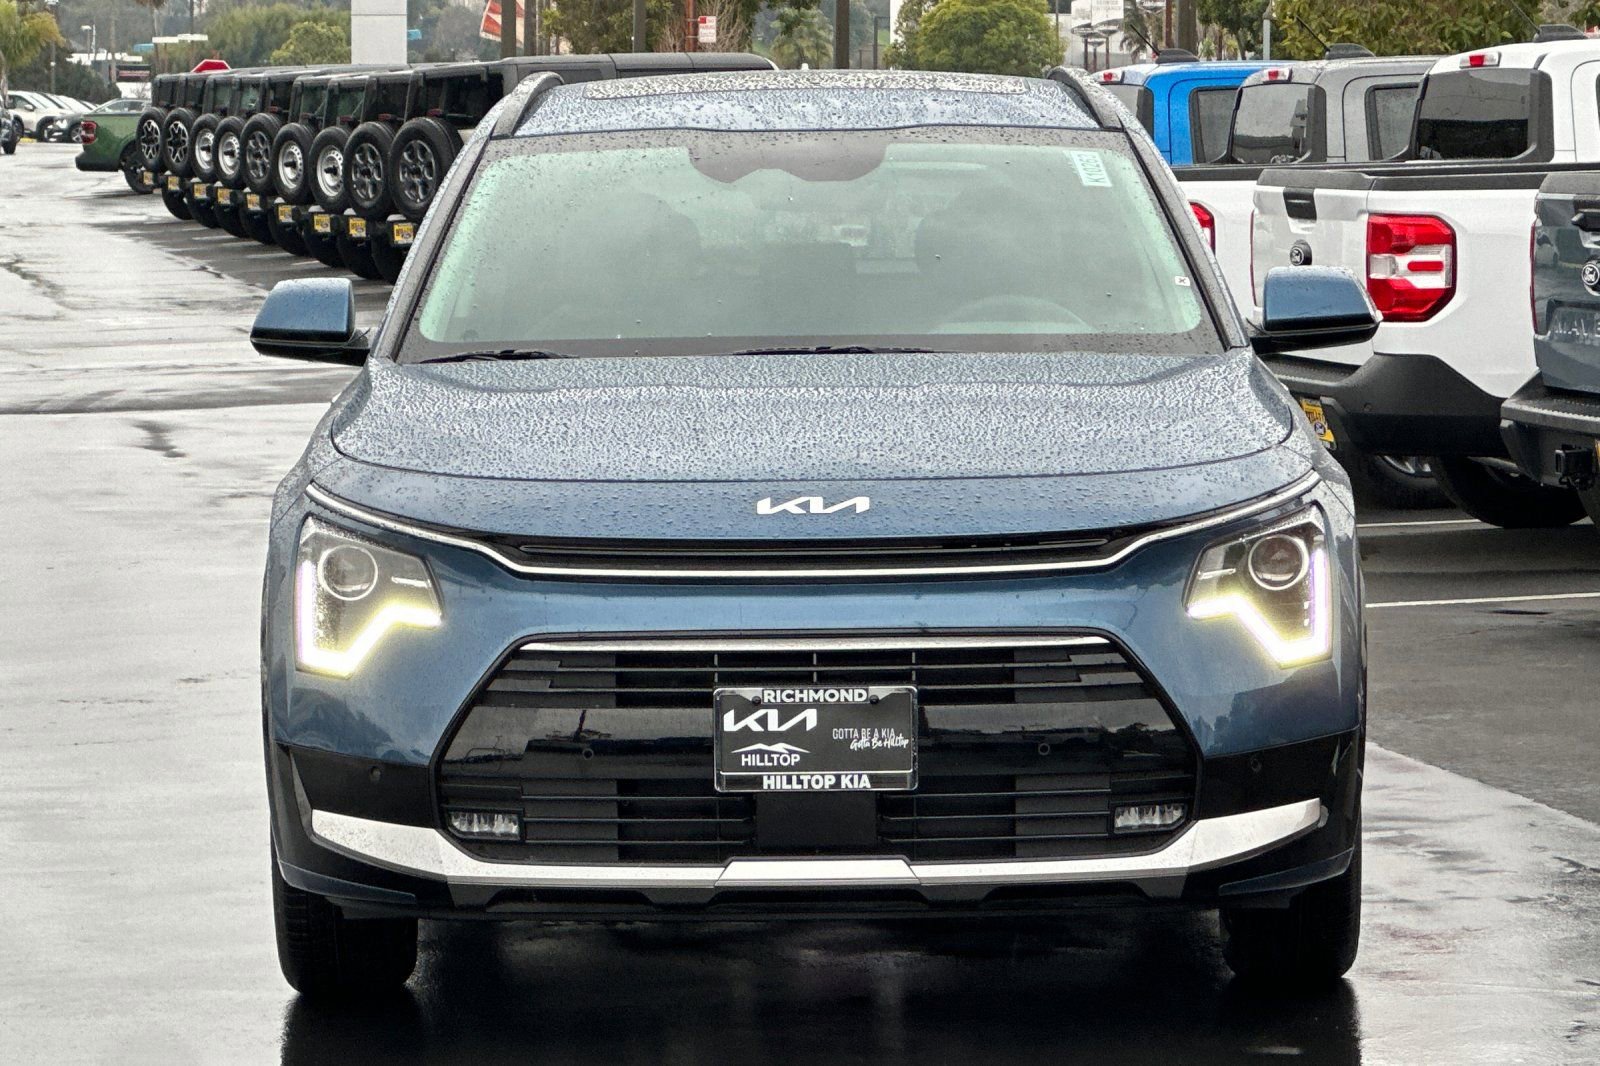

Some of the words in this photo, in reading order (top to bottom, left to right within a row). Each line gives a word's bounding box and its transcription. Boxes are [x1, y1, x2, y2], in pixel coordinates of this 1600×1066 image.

[757, 496, 870, 515] KIA
[763, 689, 868, 703] RICHMOND
[723, 708, 818, 732] KIA
[832, 728, 859, 740] GOTTA
[861, 728, 871, 739] BE
[873, 728, 879, 739] A
[881, 728, 896, 739] KIA
[850, 738, 870, 751] Gotta
[871, 737, 883, 749] Be
[883, 733, 909, 749] Hilltop
[741, 753, 801, 767] HILLTOP
[762, 774, 836, 790] HILLTOP
[841, 774, 871, 789] KIA
